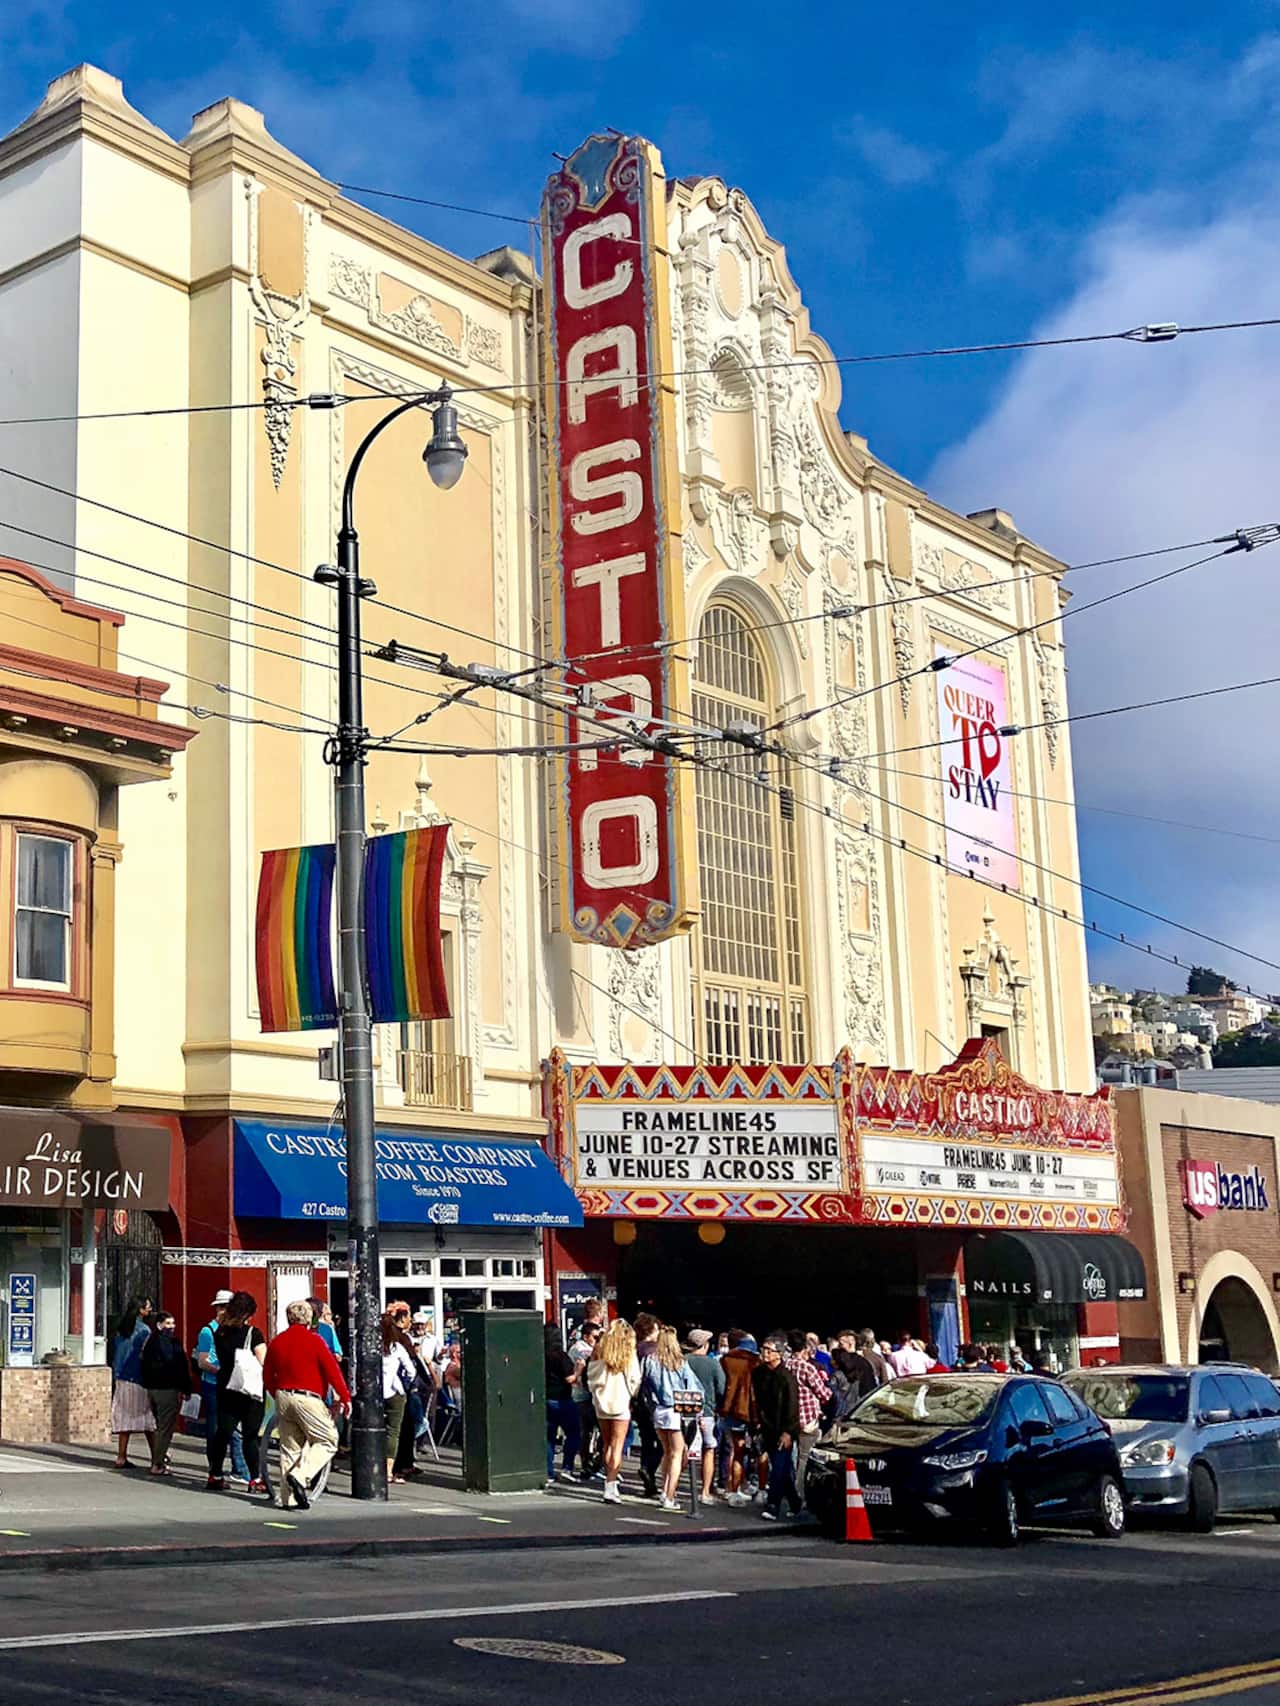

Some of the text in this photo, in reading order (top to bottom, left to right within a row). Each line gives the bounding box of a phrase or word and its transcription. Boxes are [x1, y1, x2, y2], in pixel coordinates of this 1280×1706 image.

[561, 210, 660, 891] CASTRO
[943, 684, 996, 723] QUEER
[952, 714, 1001, 780] TO
[949, 765, 1001, 811] STAY
[622, 1111, 777, 1132] FRAMELINE45
[955, 1091, 1032, 1127] CASTRO
[25, 1132, 83, 1163] Lisa
[375, 1140, 443, 1163] OFFEE
[443, 1144, 538, 1168] COMPANY
[579, 1135, 838, 1157] JUNE 10-27 STREAMING
[337, 1161, 508, 1187] CTOM ROASTERS
[585, 1158, 833, 1181] & VENUES ACROSS SF
[944, 1147, 1006, 1171] FRAMELINE45
[1011, 1153, 1032, 1174] JUNE
[44, 1167, 144, 1199] DESIGN
[412, 1184, 439, 1197] Since
[302, 1203, 346, 1217] 427 Castro
[493, 1212, 570, 1224] www.castro-coffee.com
[974, 1280, 1032, 1294] NAILS
